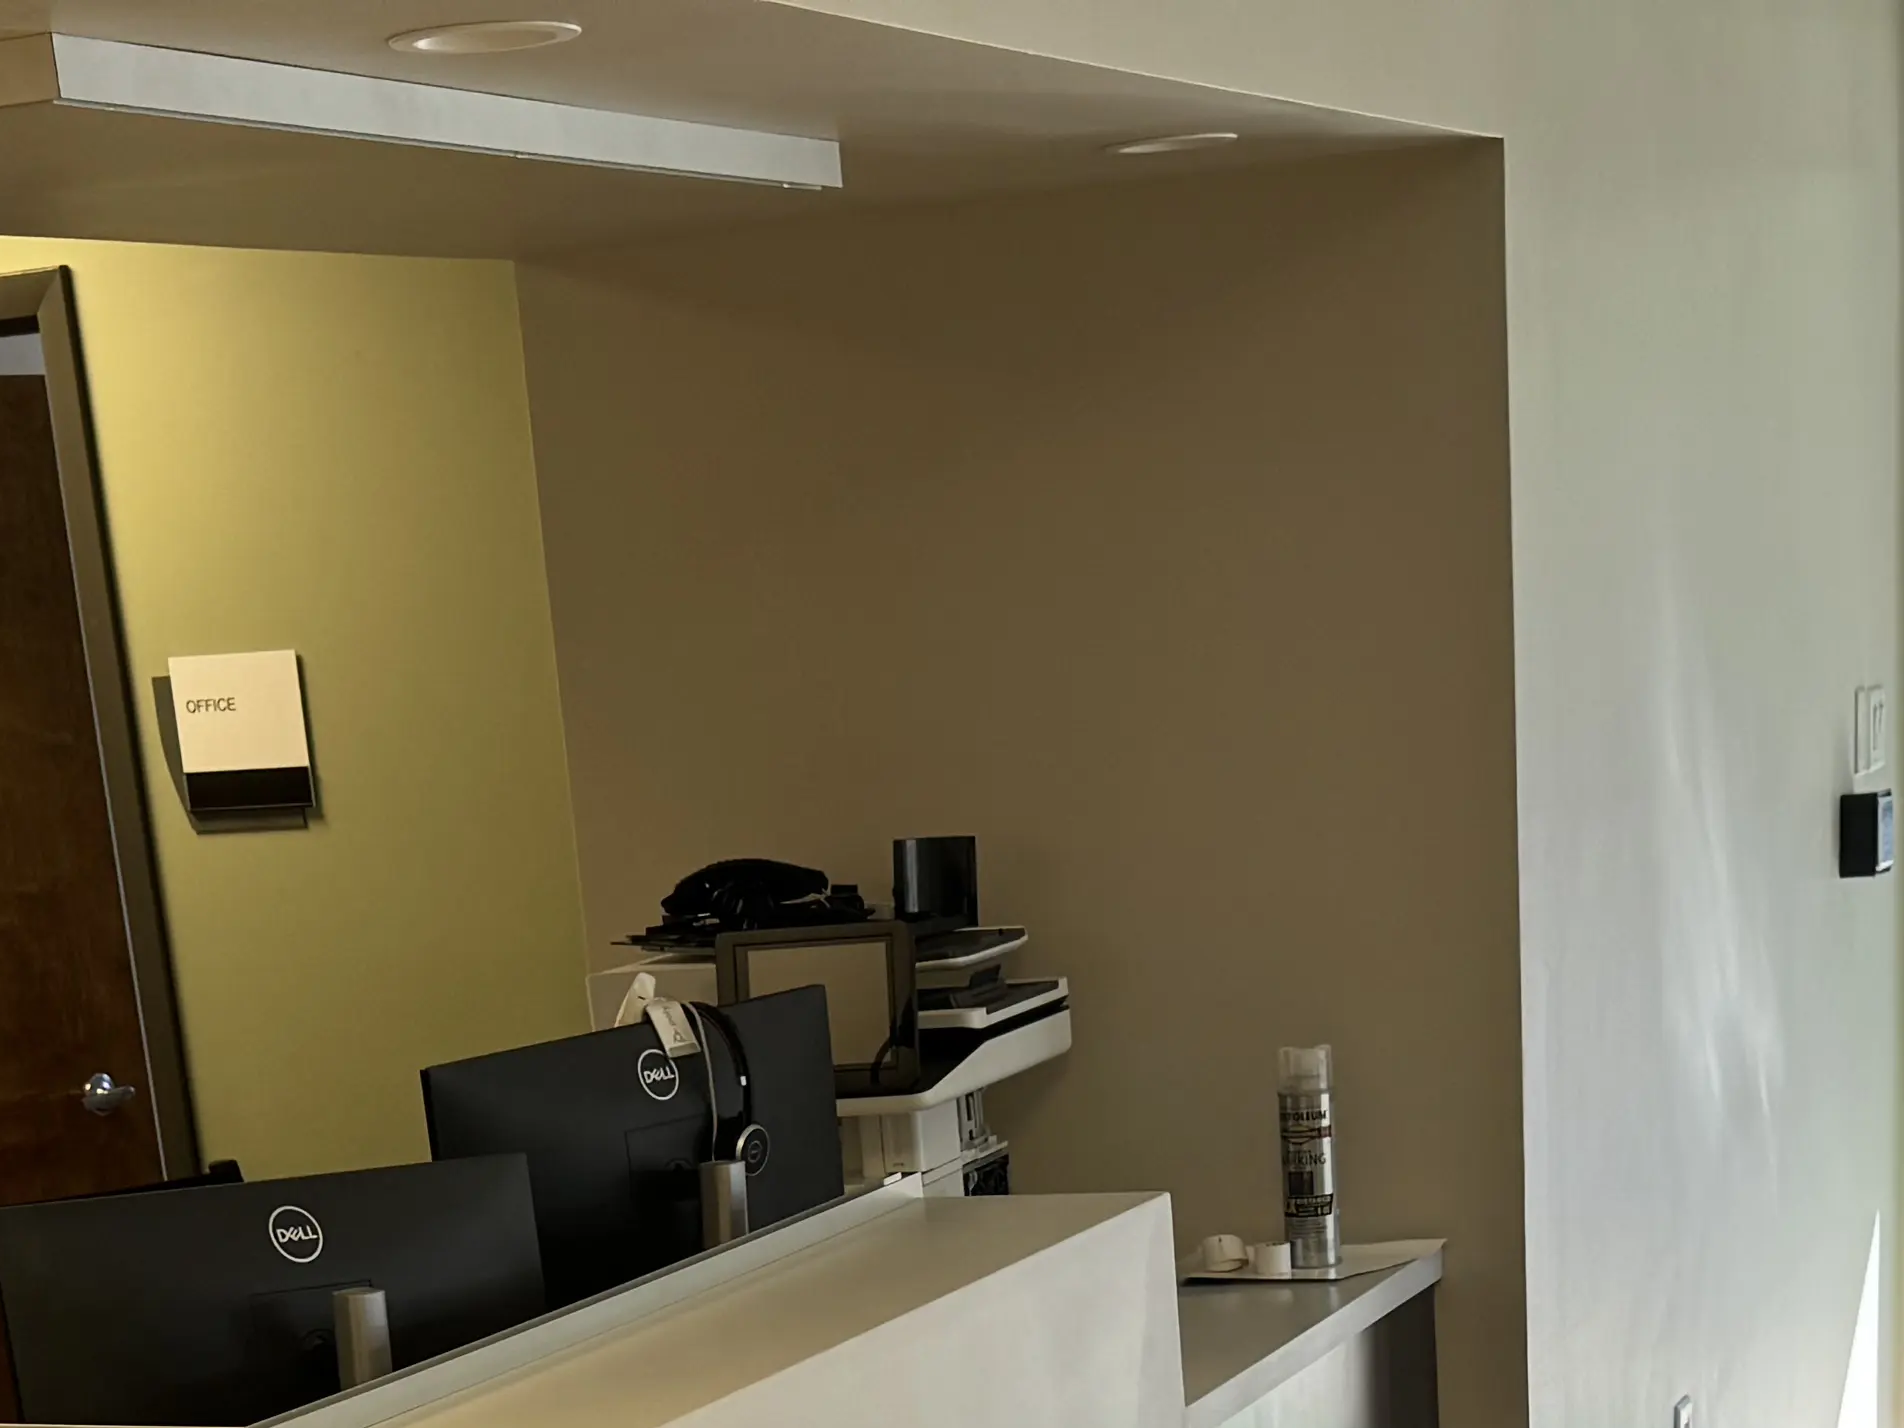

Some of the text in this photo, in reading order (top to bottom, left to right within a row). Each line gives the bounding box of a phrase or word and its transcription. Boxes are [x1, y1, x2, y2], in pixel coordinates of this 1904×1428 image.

[185, 697, 236, 713] OFFICE
[643, 1066, 675, 1084] DELL
[276, 1224, 318, 1243] DELL
